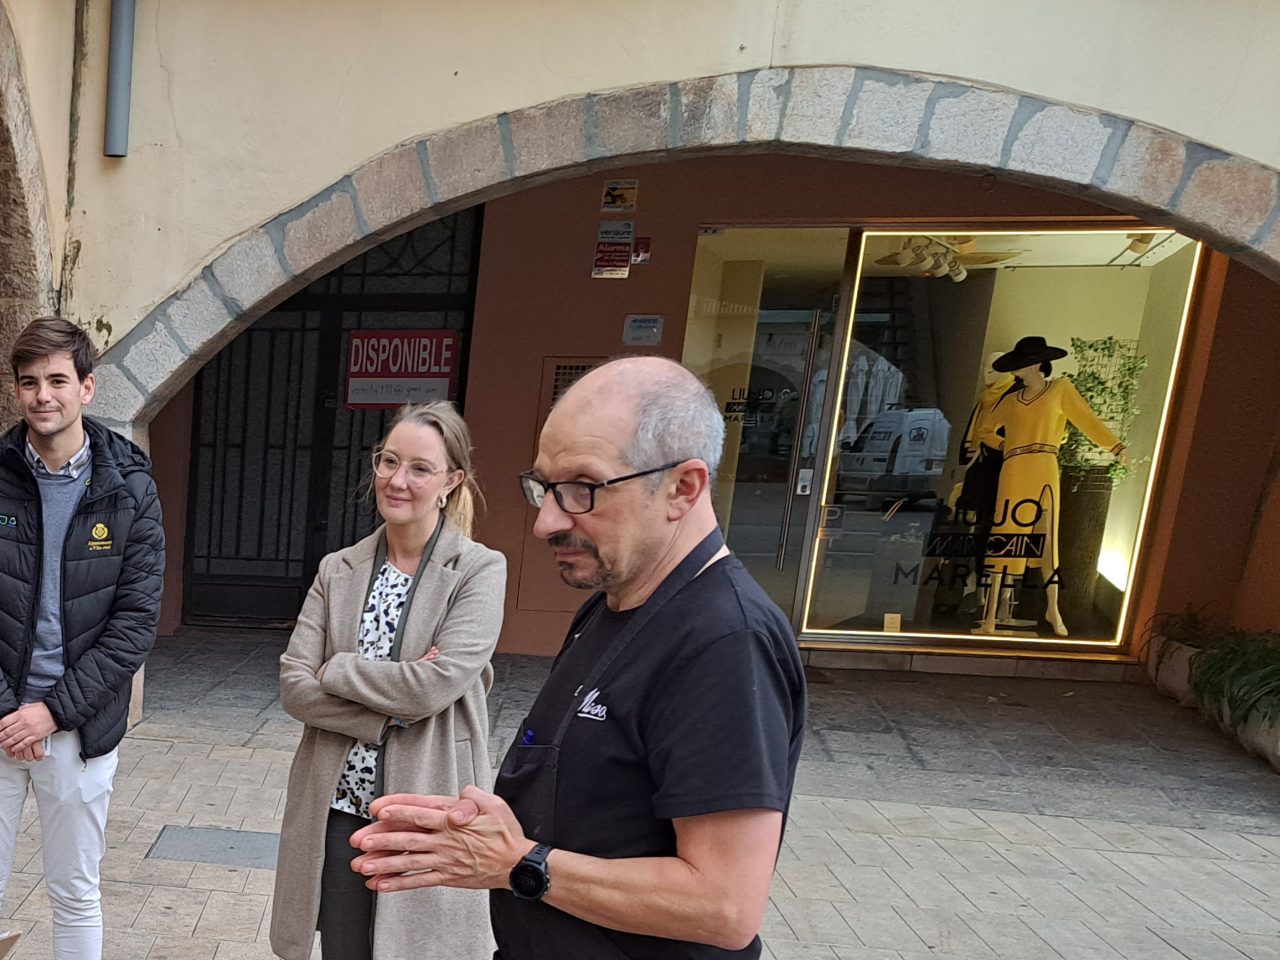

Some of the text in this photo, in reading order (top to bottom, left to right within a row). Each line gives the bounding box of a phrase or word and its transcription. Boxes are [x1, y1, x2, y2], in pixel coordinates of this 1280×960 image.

[598, 243, 630, 251] Alarma
[350, 337, 453, 373] DISPONIBLE
[893, 562, 1065, 590] MARELLA
